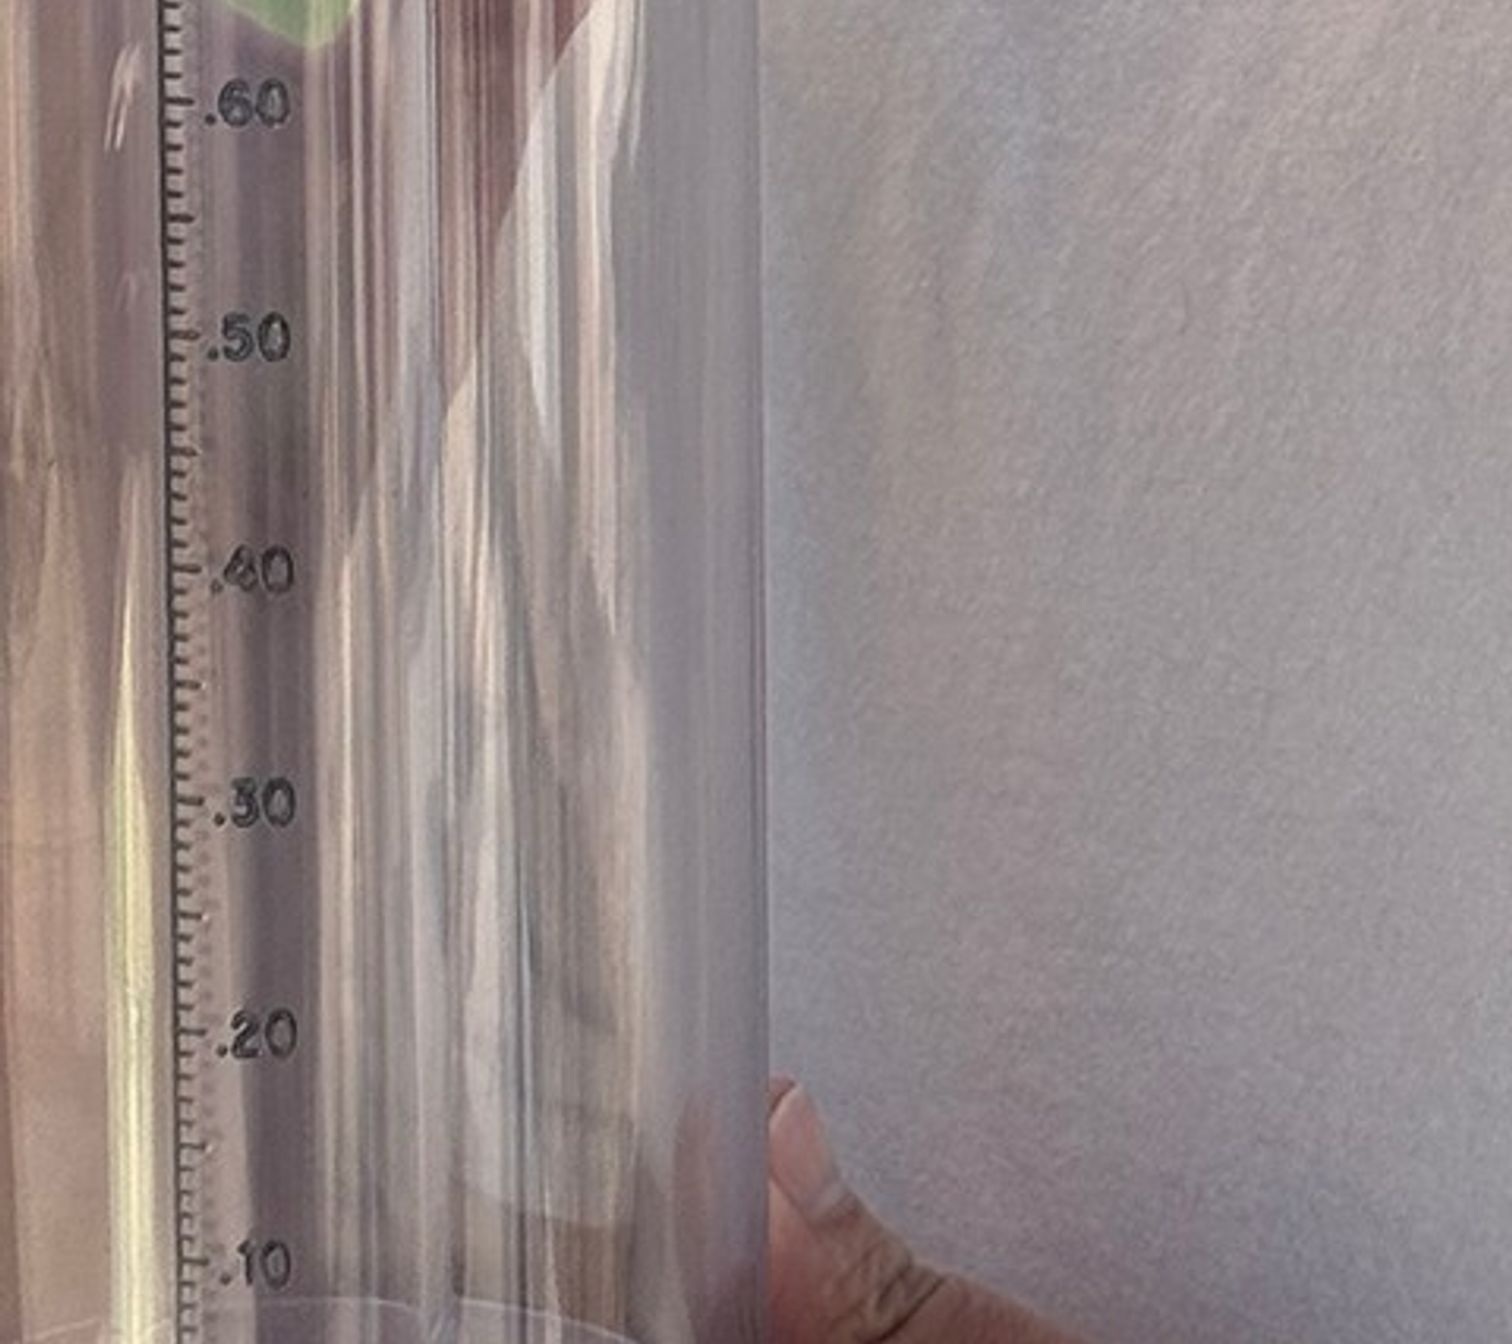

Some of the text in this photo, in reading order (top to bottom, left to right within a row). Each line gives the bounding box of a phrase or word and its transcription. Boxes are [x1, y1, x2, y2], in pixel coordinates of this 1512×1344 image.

[205, 78, 289, 127] .60
[207, 312, 291, 362] .50
[211, 545, 294, 593] .40
[214, 777, 297, 828] .30
[217, 1009, 298, 1059] .20
[220, 1240, 291, 1288] .10
